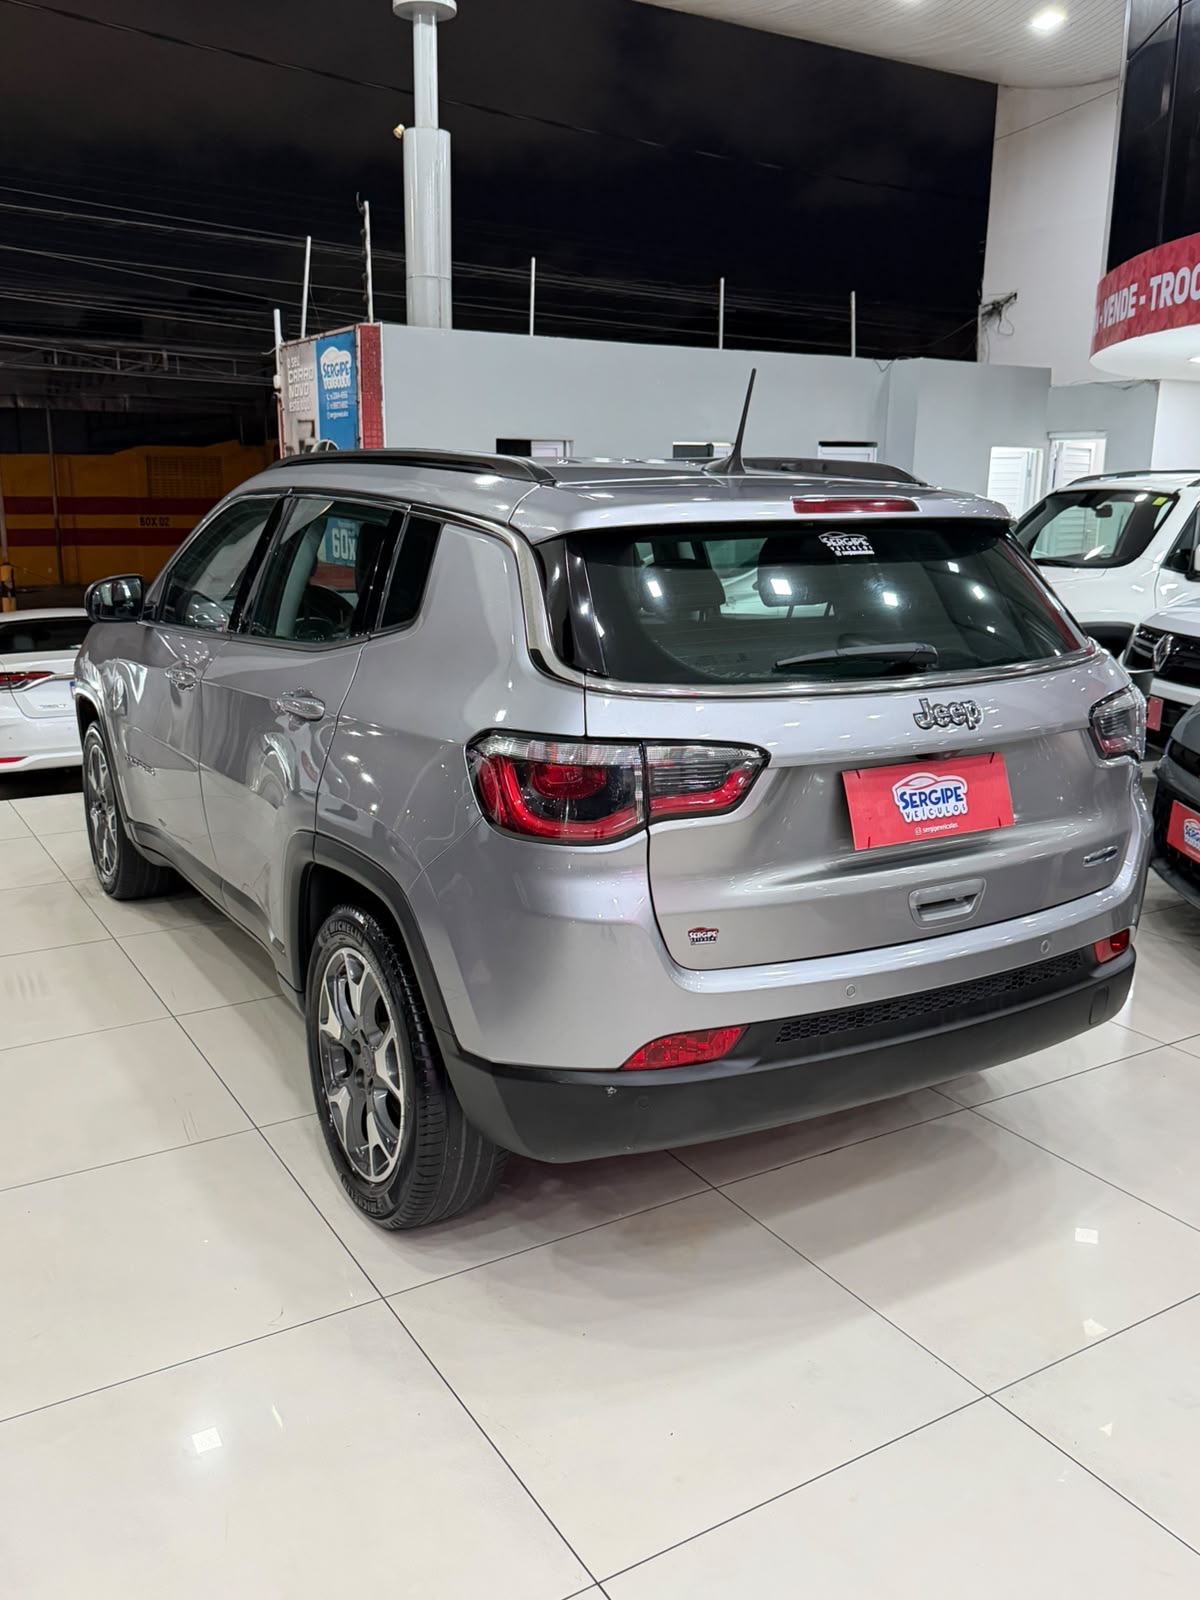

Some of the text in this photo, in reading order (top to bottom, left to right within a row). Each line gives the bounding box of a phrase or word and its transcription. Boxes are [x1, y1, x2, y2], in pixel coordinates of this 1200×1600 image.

[1103, 282, 1138, 329] VENDE
[288, 367, 314, 383] CARRO
[322, 361, 350, 378] SERGIPE
[289, 383, 310, 398] NOVO
[140, 516, 157, 527] BOX
[822, 537, 869, 546] SERGIPE
[912, 698, 981, 730] Jeep
[900, 786, 964, 810] SERGIPE
[905, 804, 966, 819] VEÍCULOS
[329, 920, 364, 946] MICHELIN
